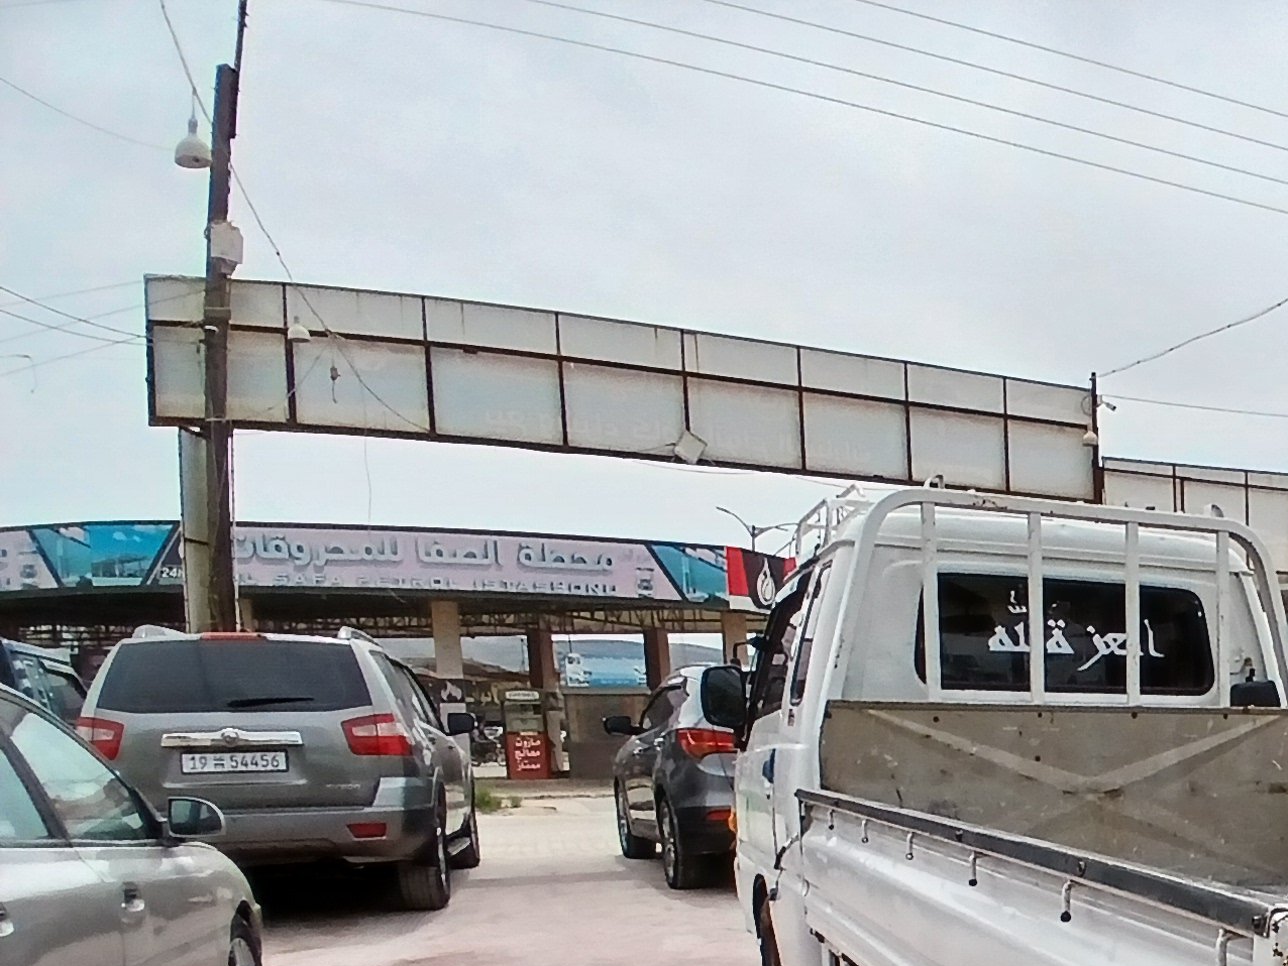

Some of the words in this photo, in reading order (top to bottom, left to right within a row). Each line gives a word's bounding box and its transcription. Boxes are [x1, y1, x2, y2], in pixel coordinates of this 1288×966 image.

[415, 537, 504, 566] الصفا
[517, 540, 614, 571] محطة
[189, 756, 207, 770] 19
[230, 754, 280, 769] 54456
